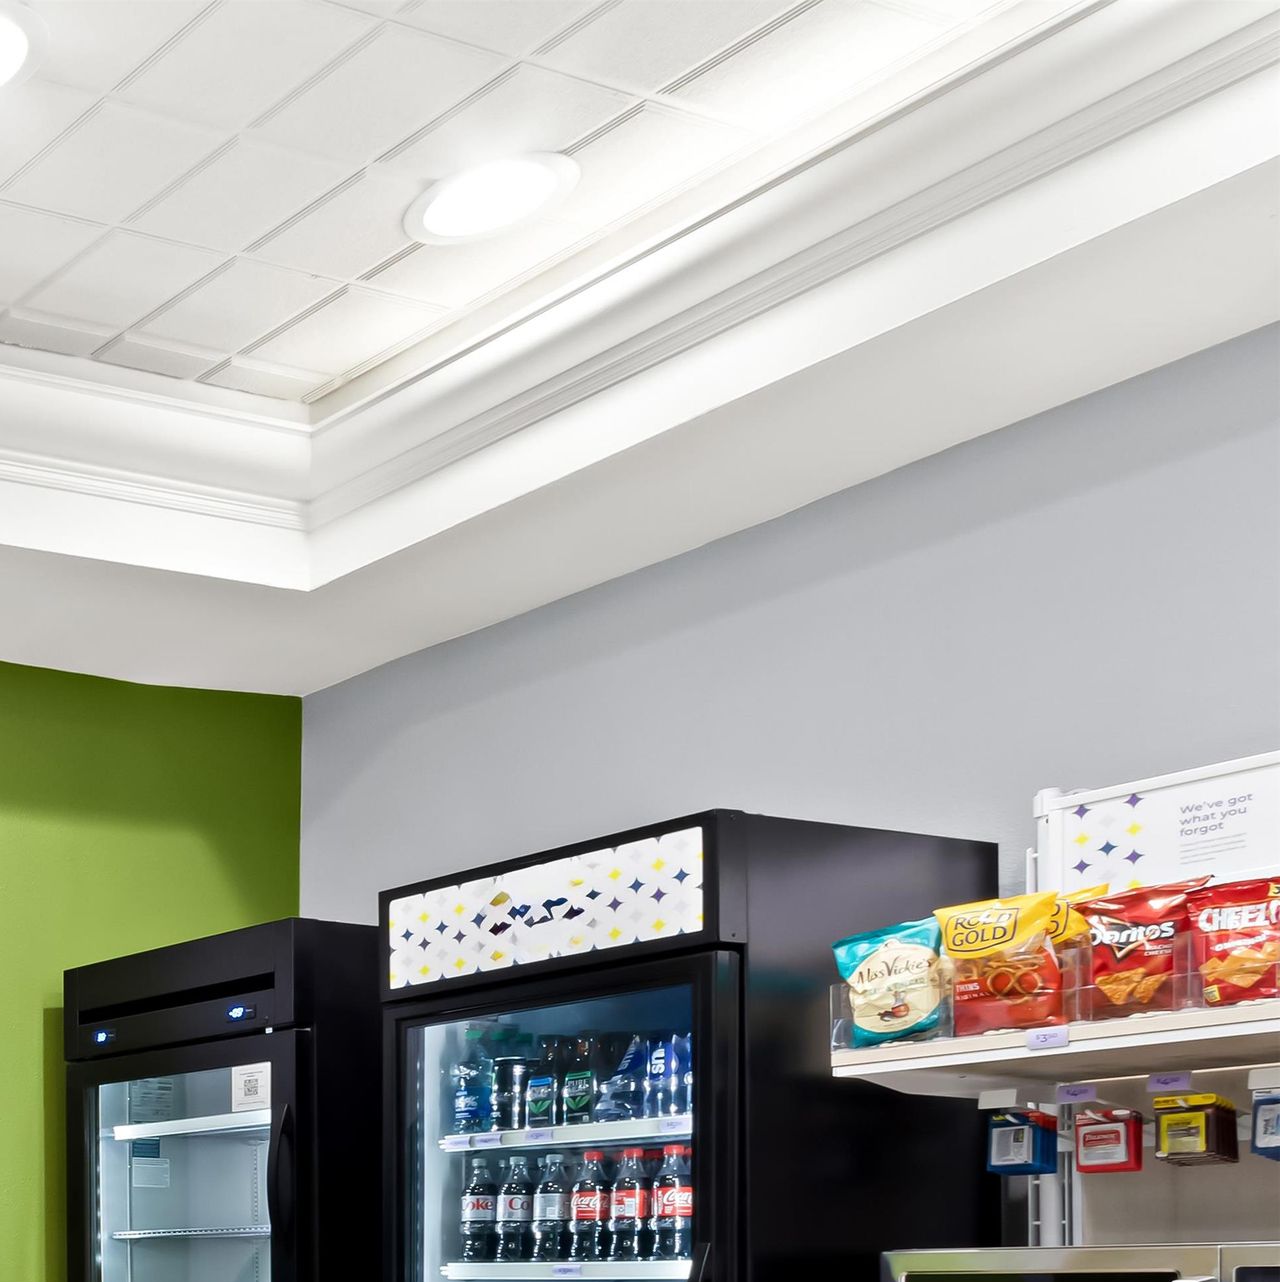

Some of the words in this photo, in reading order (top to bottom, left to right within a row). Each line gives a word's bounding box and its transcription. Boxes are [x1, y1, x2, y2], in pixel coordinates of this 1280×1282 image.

[1180, 801, 1224, 815] We've
[1227, 793, 1253, 807] got
[1179, 811, 1217, 826] what
[1220, 806, 1248, 820] you
[1179, 822, 1225, 837] forgot
[951, 926, 1008, 947] GOLD
[1090, 918, 1175, 946] Doritos
